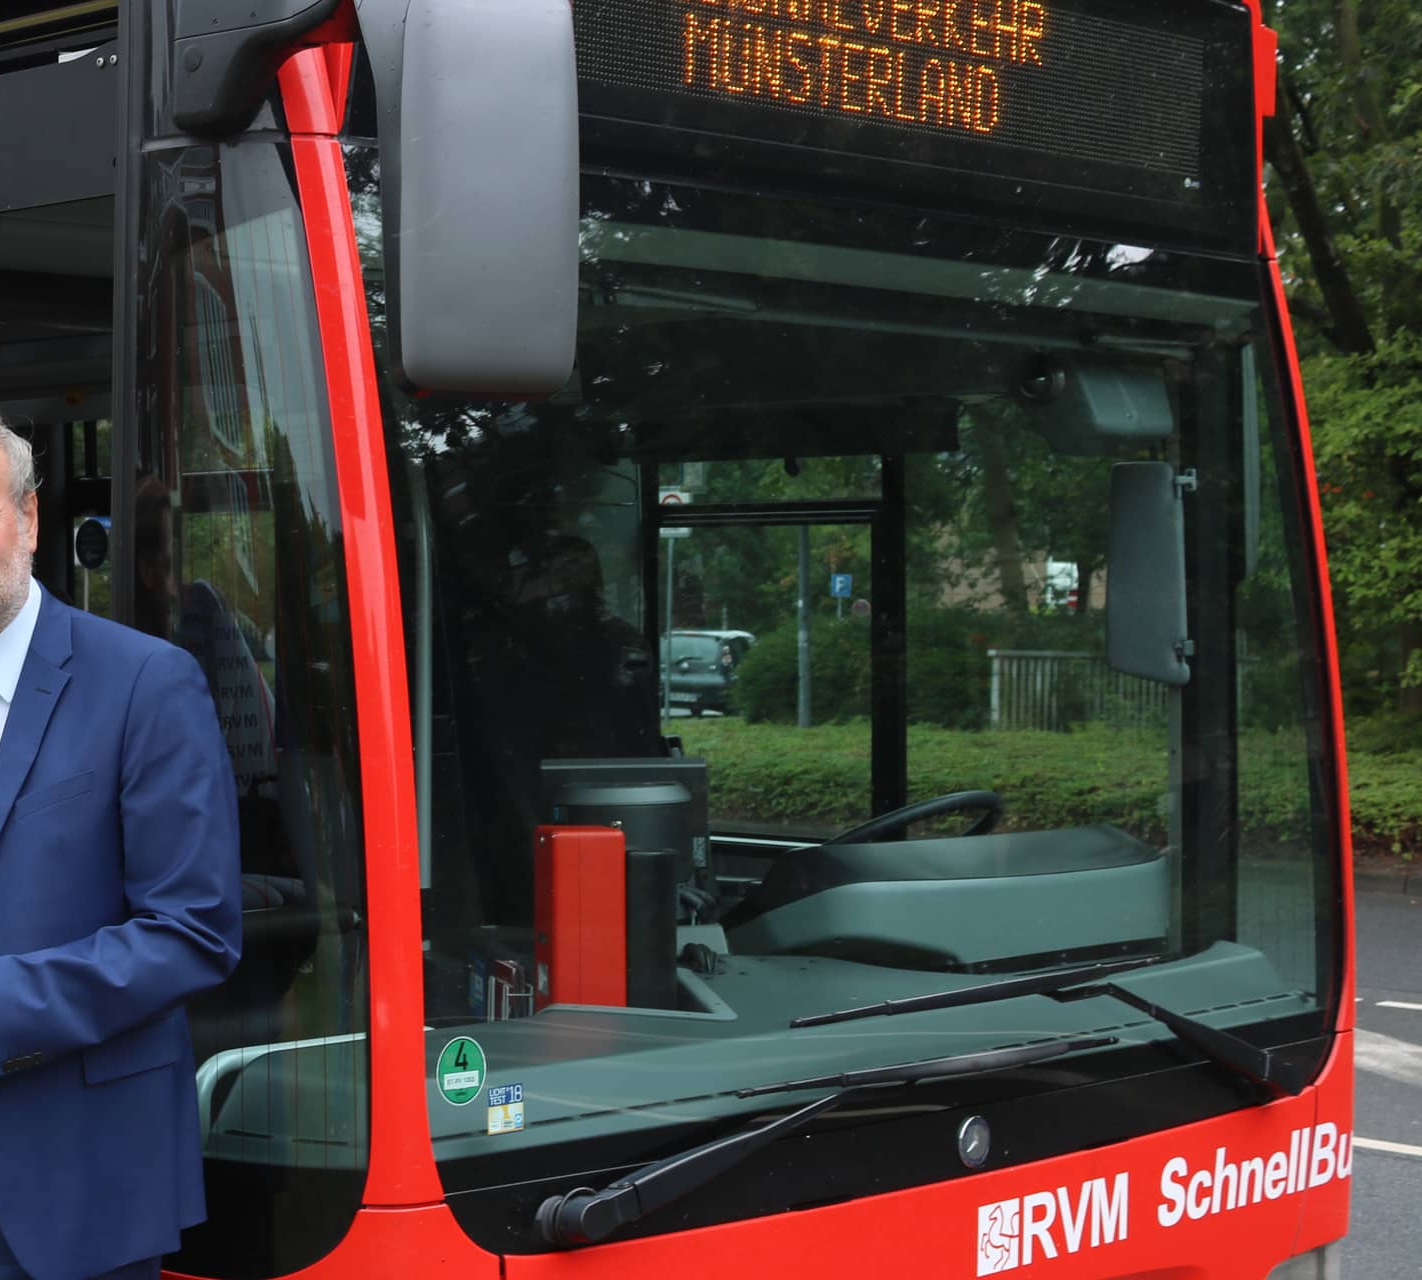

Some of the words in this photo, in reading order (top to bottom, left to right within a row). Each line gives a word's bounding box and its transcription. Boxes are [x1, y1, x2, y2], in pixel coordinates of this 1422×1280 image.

[682, 11, 1001, 134] MÜNSTERLAND
[220, 685, 254, 700] RVM
[454, 1041, 469, 1071] 4
[489, 1096, 507, 1106] TEST
[1022, 1171, 1129, 1267] RVM
